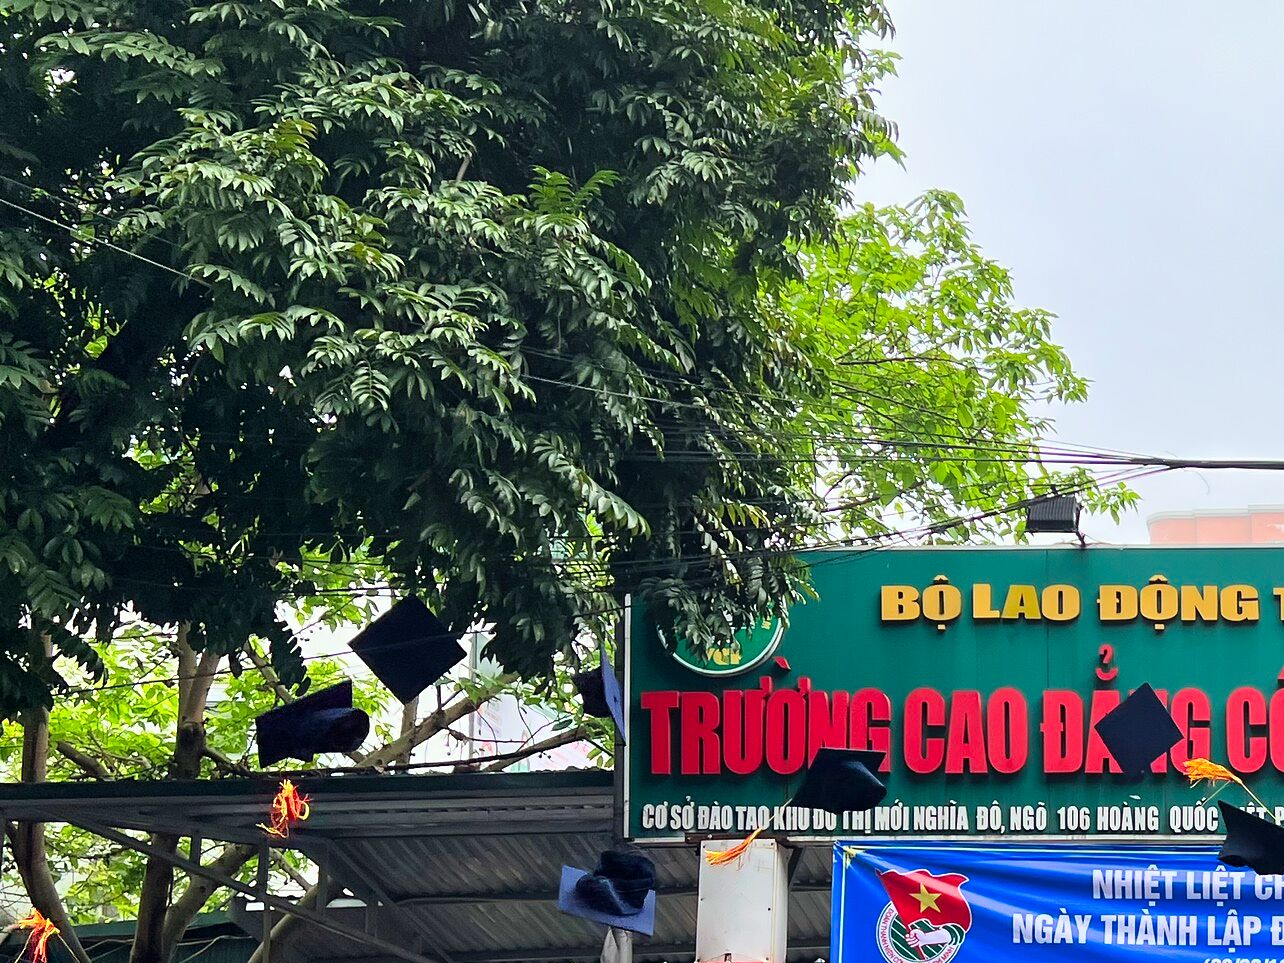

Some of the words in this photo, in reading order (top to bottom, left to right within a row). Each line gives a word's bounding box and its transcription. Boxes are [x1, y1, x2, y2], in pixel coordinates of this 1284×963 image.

[881, 573, 962, 631] BỘ
[973, 583, 1081, 622] LAO
[1097, 573, 1261, 631] ĐỘNG
[640, 654, 892, 776] TRƯỜNG
[903, 686, 1028, 775] CAO
[1040, 643, 1212, 776] ĐẲG
[642, 802, 669, 830] CƠ
[670, 796, 695, 830] SỞ
[697, 801, 734, 830] ĐÀO
[773, 805, 810, 831] KHU
[875, 798, 909, 831] MỚI
[976, 800, 1006, 834] ĐÔ,
[1010, 801, 1047, 831] NGÕ
[1057, 805, 1089, 831] 106
[1097, 800, 1159, 831] HOÀNG
[1169, 797, 1218, 833] QUỐC
[1091, 863, 1181, 907] NHIỆT
[1186, 864, 1246, 907] LIỆT
[1012, 907, 1092, 945] NGÀY
[1102, 907, 1198, 946] THÀNH
[1208, 907, 1261, 953] LẬP
